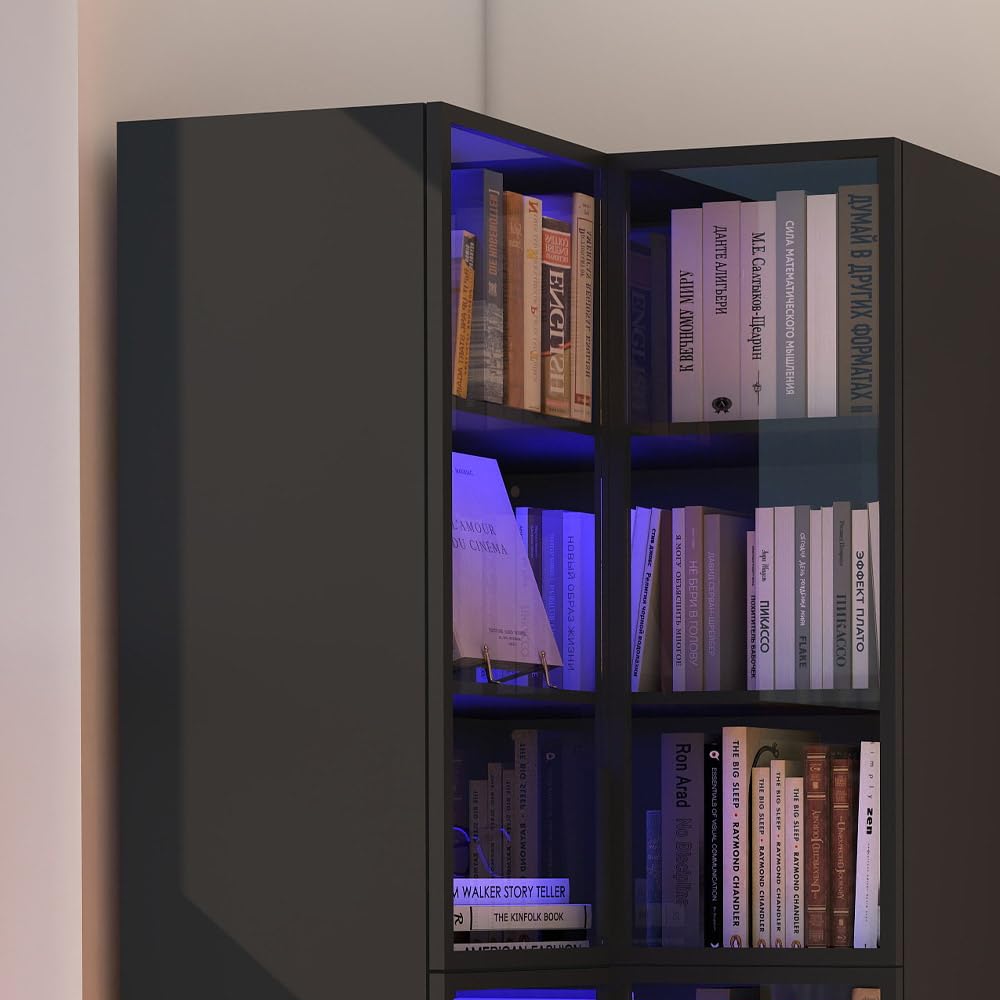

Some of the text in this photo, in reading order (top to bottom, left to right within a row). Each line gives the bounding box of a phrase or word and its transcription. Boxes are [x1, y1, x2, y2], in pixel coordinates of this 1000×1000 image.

[848, 194, 878, 244] ДУМАЙ
[851, 250, 872, 258] В
[713, 226, 728, 315] ДАНТЕ АЛИГЬЕРИ
[785, 220, 795, 395] СИЛА МАТЕМАТИЧЕСКОГО МЫШЛЕНИЯ
[848, 264, 872, 319] ДРУГИХ
[679, 270, 695, 373] К ВЕЧНОМУ МИРУ
[851, 324, 873, 400] ФОРМАТАХ
[688, 560, 698, 576] НЕ
[688, 578, 698, 604] БЕРИ
[856, 551, 864, 652] ЭФФЕКТ ПЛАТО
[688, 610, 698, 618] В
[759, 600, 770, 653] ПИКАССО
[688, 621, 698, 666] ГОЛОВУ
[836, 594, 847, 667] ПИКАССО
[799, 636, 807, 668] FLAKE
[676, 743, 691, 771] Ron
[732, 740, 740, 758] THE
[732, 761, 740, 778] BIG
[676, 776, 691, 808] Arad
[732, 781, 740, 808] SLEEP
[712, 808, 718, 817] OF
[462, 886, 566, 898] WALKER STORY TELLER
[494, 912, 564, 922] THE KINFOLK BOOK
